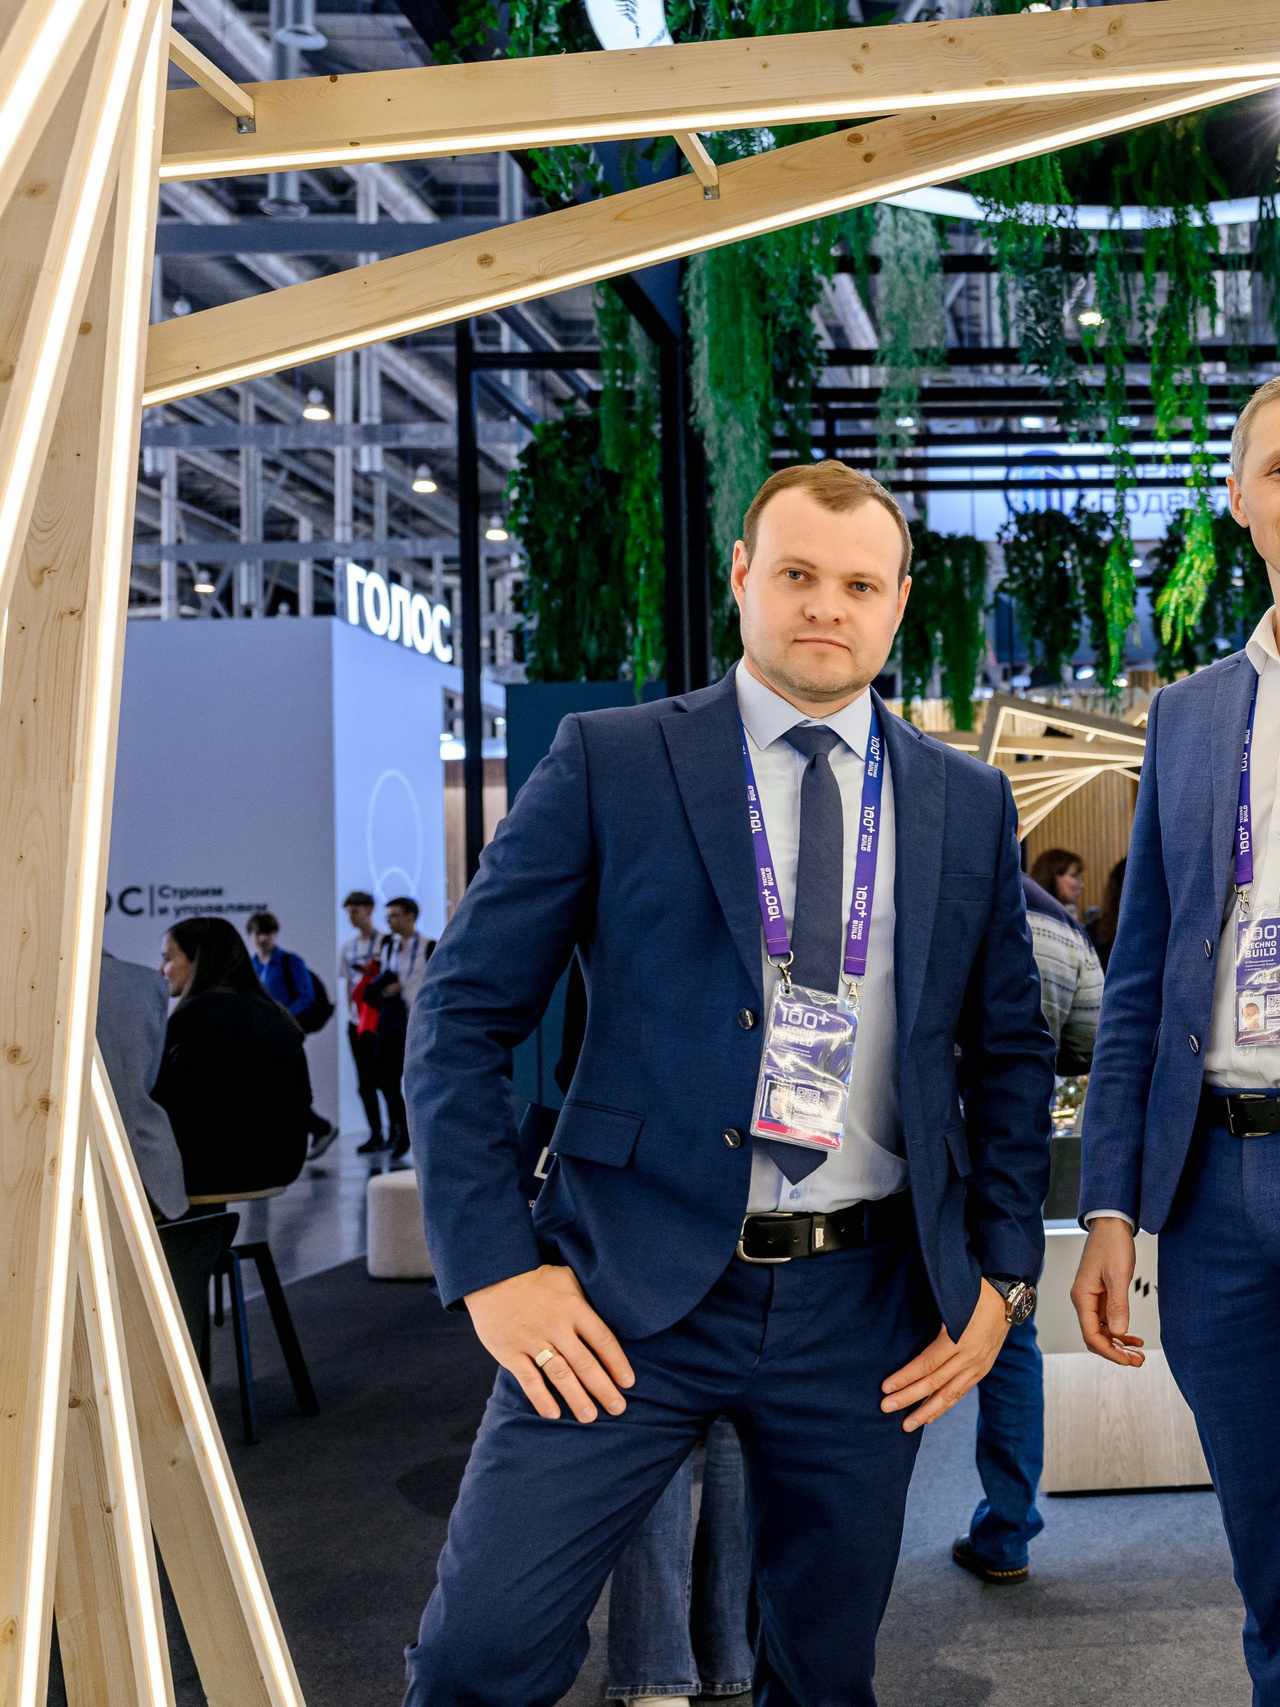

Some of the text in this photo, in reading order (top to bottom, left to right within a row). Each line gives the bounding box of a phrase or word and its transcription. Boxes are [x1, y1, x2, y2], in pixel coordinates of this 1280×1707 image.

[346, 561, 453, 663] ГОЛОС
[870, 735, 881, 762] 100+
[749, 806, 763, 834] 100
[863, 806, 875, 834] 100+
[1237, 825, 1250, 856] 100+
[158, 885, 224, 899] Строим
[762, 888, 781, 922] 100+
[854, 885, 868, 918] 100+
[1245, 948, 1277, 958] BUILD
[781, 1006, 831, 1030] 100+
